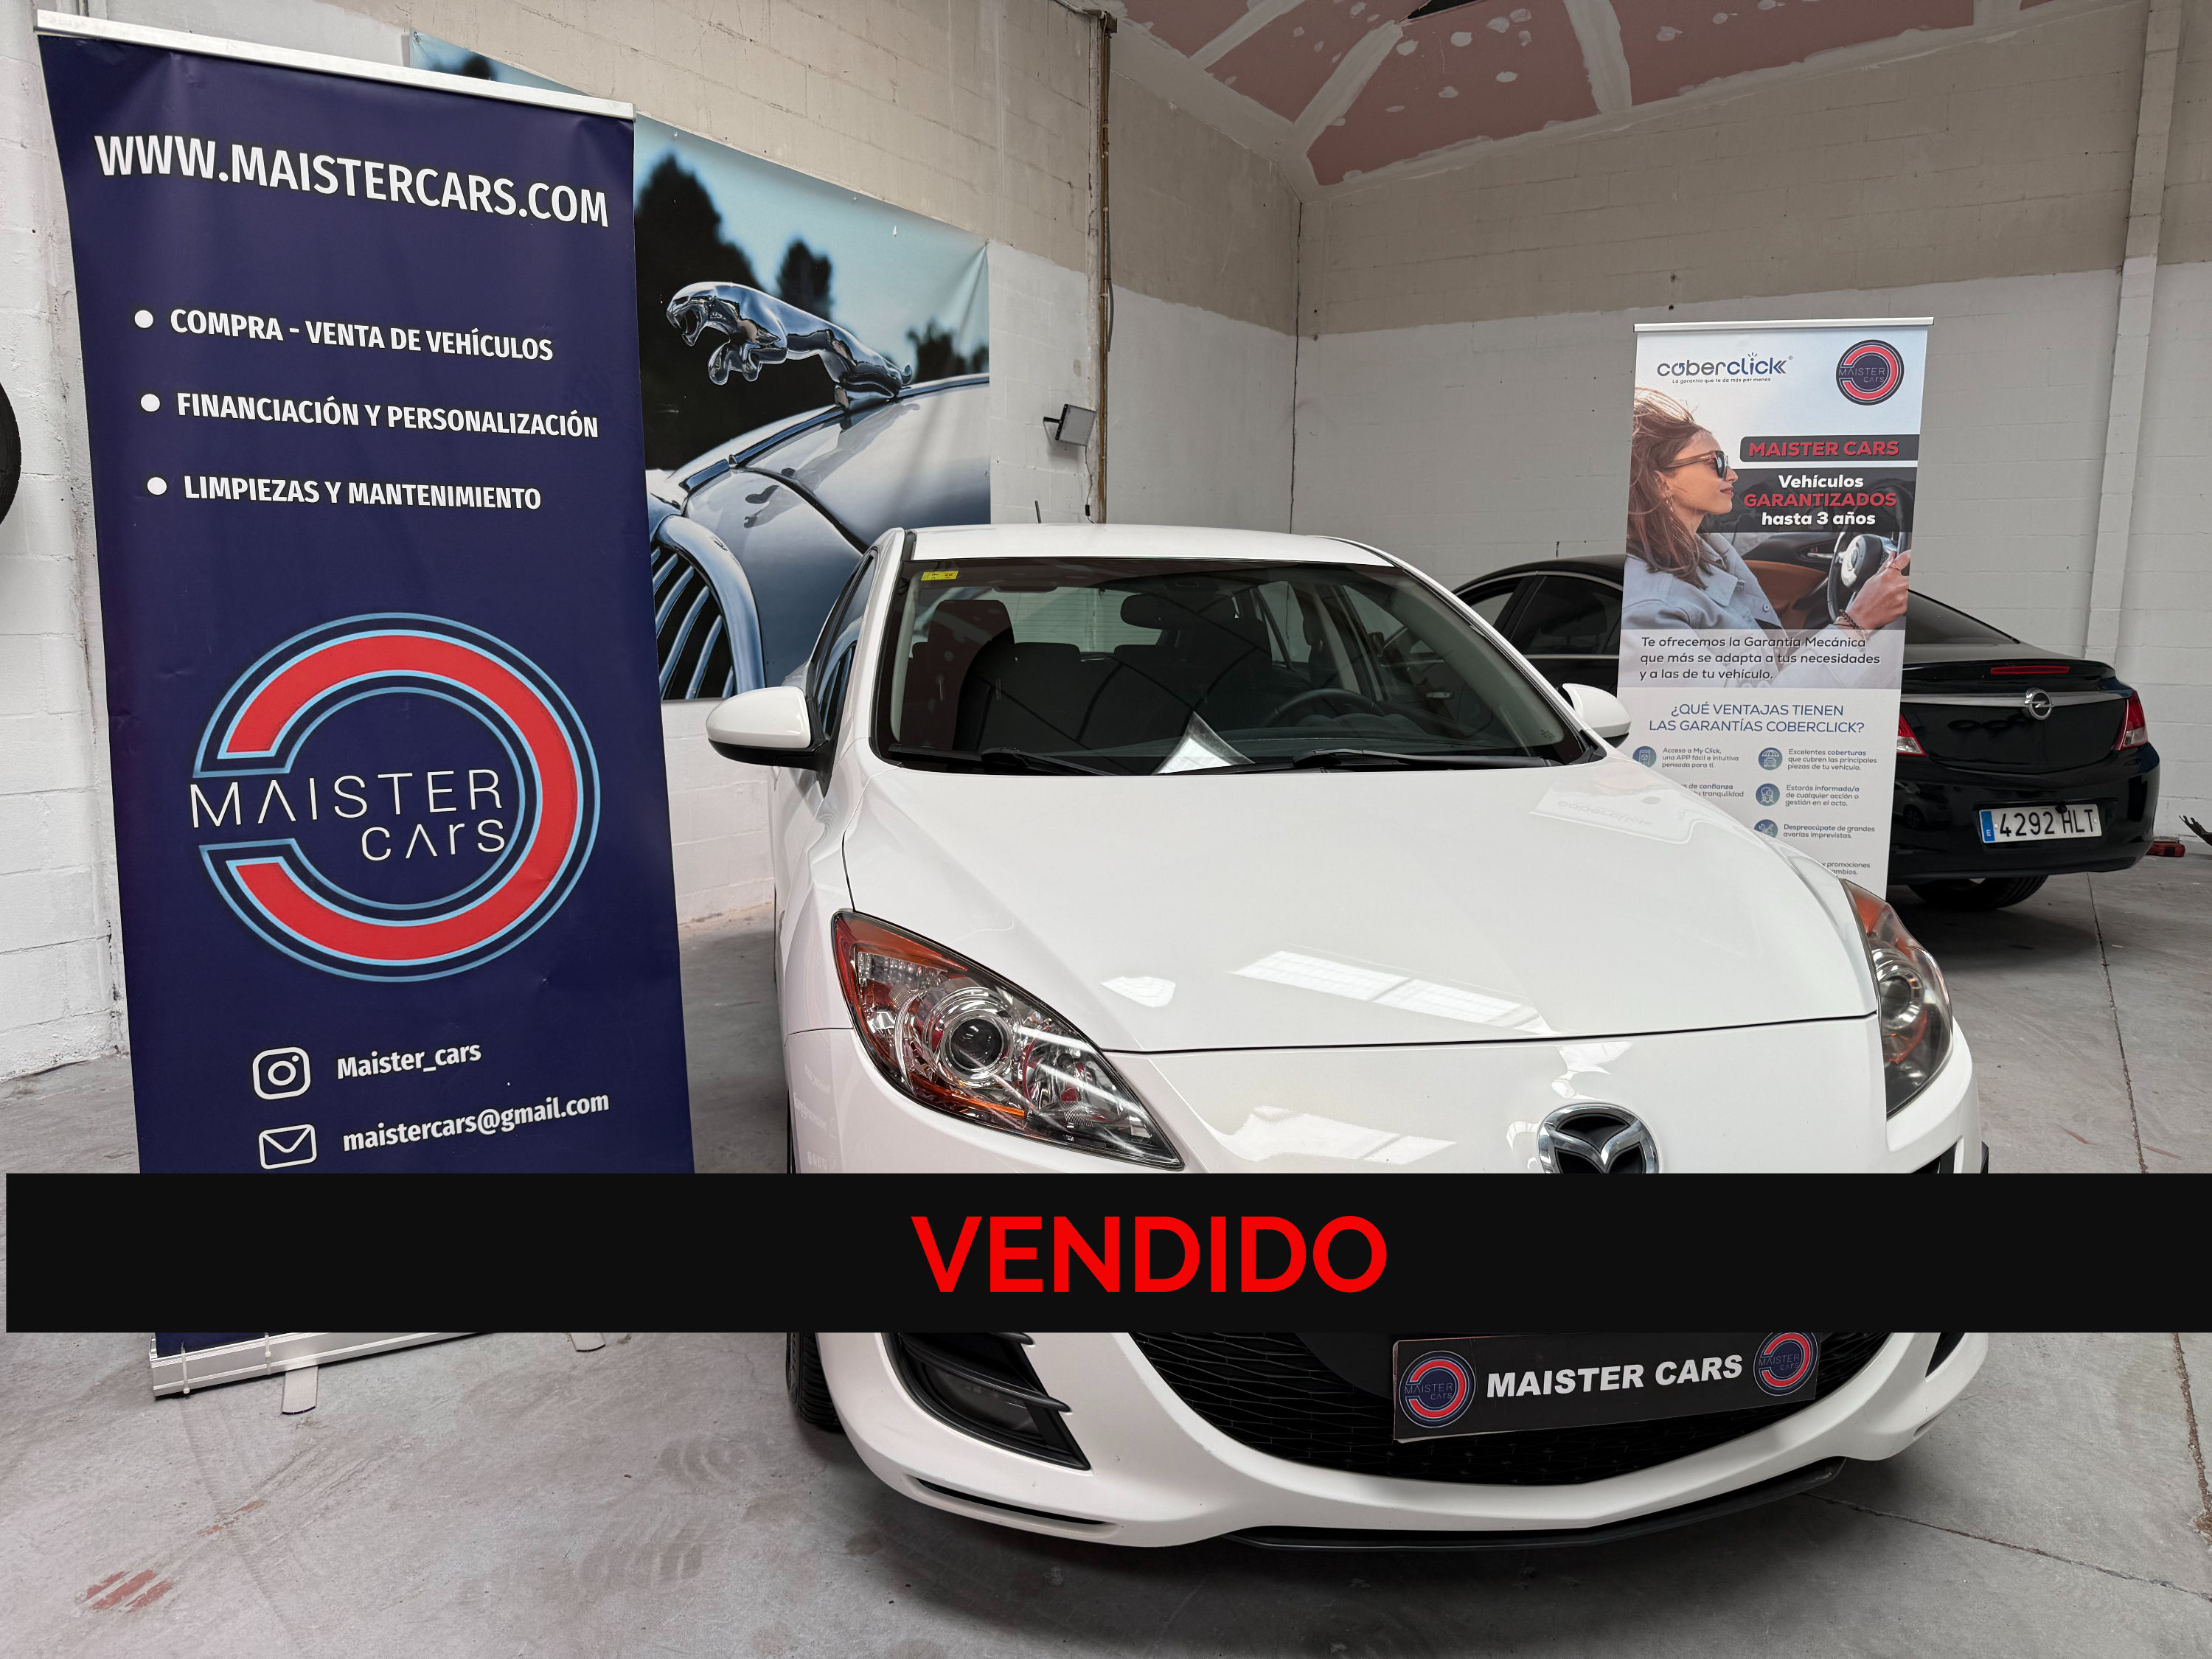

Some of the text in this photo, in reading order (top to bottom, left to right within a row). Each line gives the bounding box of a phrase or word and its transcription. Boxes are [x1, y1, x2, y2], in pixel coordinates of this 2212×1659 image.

[94, 135, 609, 228] WWW.MAISTERCARS.COM
[170, 309, 283, 341] COMPRA
[305, 321, 386, 351] VENTA
[392, 328, 422, 352] DE
[426, 324, 554, 361] VEHÍCULOS
[178, 392, 599, 438] FINANCIACIÓN Y PERSONALIZACIÓN
[1749, 441, 1899, 457] MAISTER CARS
[1778, 474, 1863, 488] Vehículos
[184, 476, 542, 510] LIMPIEZAS Y MANTENIMIENTO
[1744, 493, 1896, 507] GARANTIZADOS
[1761, 511, 1876, 526] hasta 3 años
[1641, 636, 1865, 647] Te ofrecemos la Garantía Mecánica
[1641, 655, 1664, 665] que
[1667, 653, 1694, 663] más
[1697, 655, 1711, 663] se
[1715, 653, 1761, 665] adapta
[1778, 653, 1797, 663] tus
[1801, 653, 1880, 664] necesidades
[1639, 671, 1646, 681] y
[1661, 669, 1679, 678] las
[1683, 669, 1698, 678] de
[1702, 669, 1714, 678] tu
[1671, 701, 1843, 717] ¿QUÉ VENTAJAS TIENEN
[1649, 718, 1865, 733] LAS GARANTÍAS COBERCLICK?
[189, 768, 503, 828] MAISTER
[2000, 809, 2093, 837] 4292 HLT
[337, 1044, 481, 1080] Maister_cars
[343, 1094, 610, 1152] maistercars@gmail.com
[1486, 1354, 1742, 1398] MAISTER CARS
